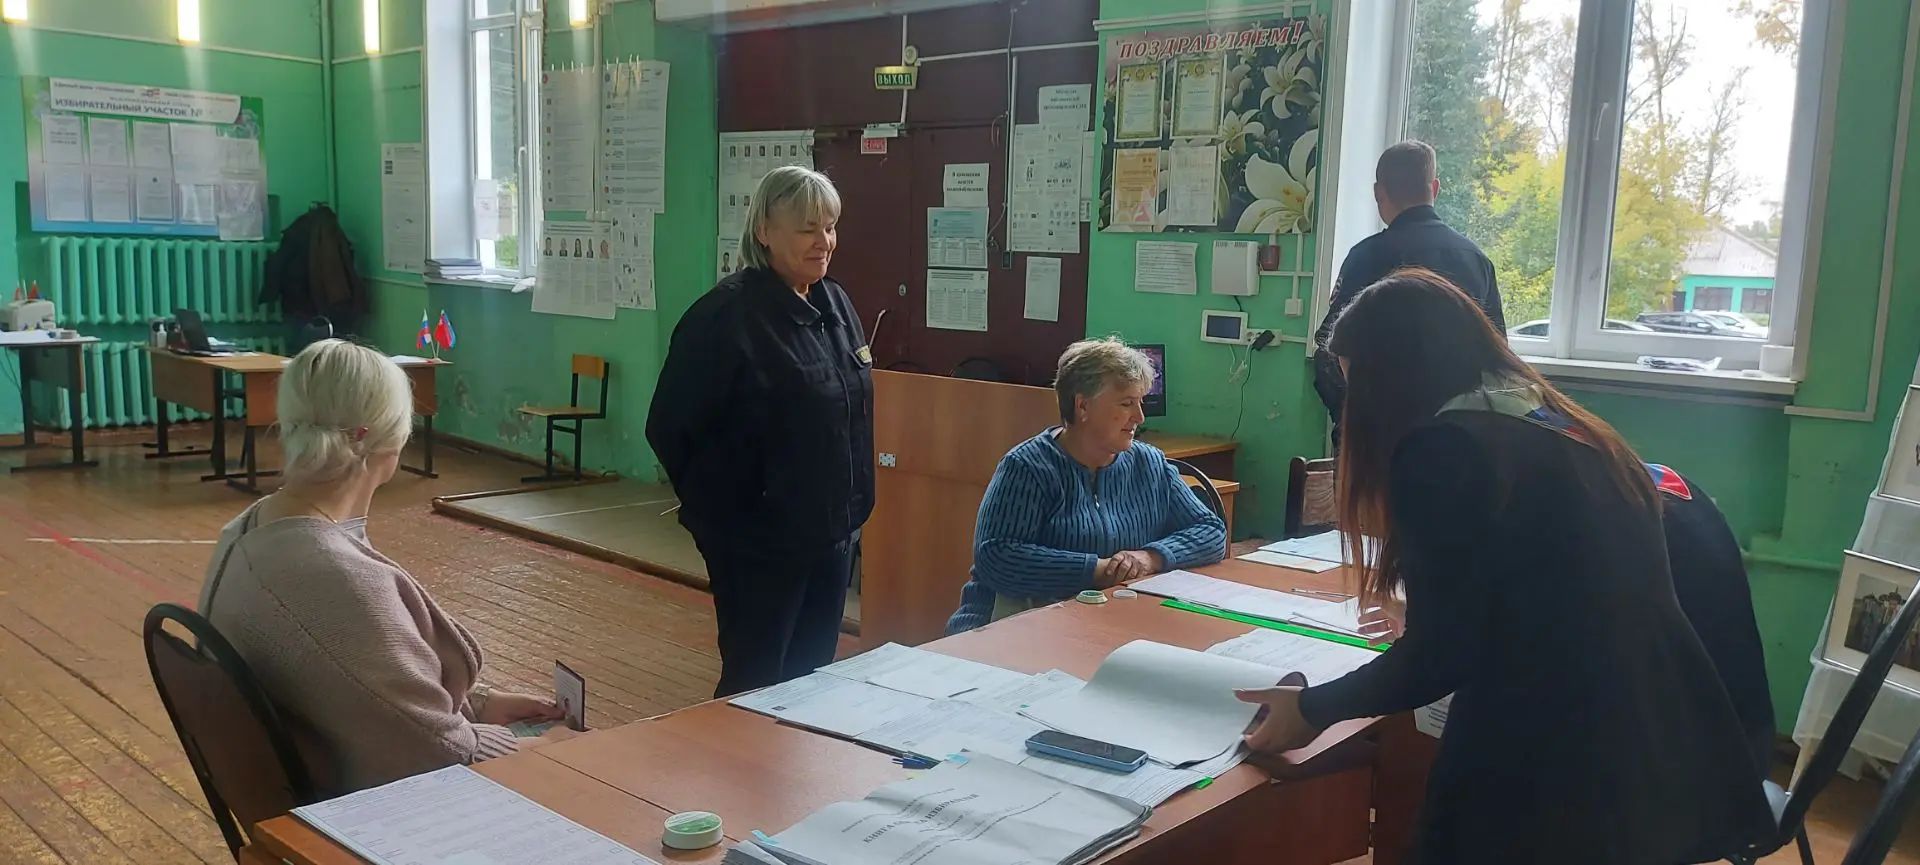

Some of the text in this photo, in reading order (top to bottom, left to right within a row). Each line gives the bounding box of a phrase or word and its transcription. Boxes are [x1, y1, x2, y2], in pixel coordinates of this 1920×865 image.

[1118, 21, 1304, 60] ПОЗДРАВЛЯЕМ!
[877, 73, 911, 85] ВЫХОД
[54, 98, 141, 113] ИЗБИРАТЕЛЬНЫЙ
[144, 105, 187, 117] УЧАСТОК
[863, 824, 895, 844] КНИГА
